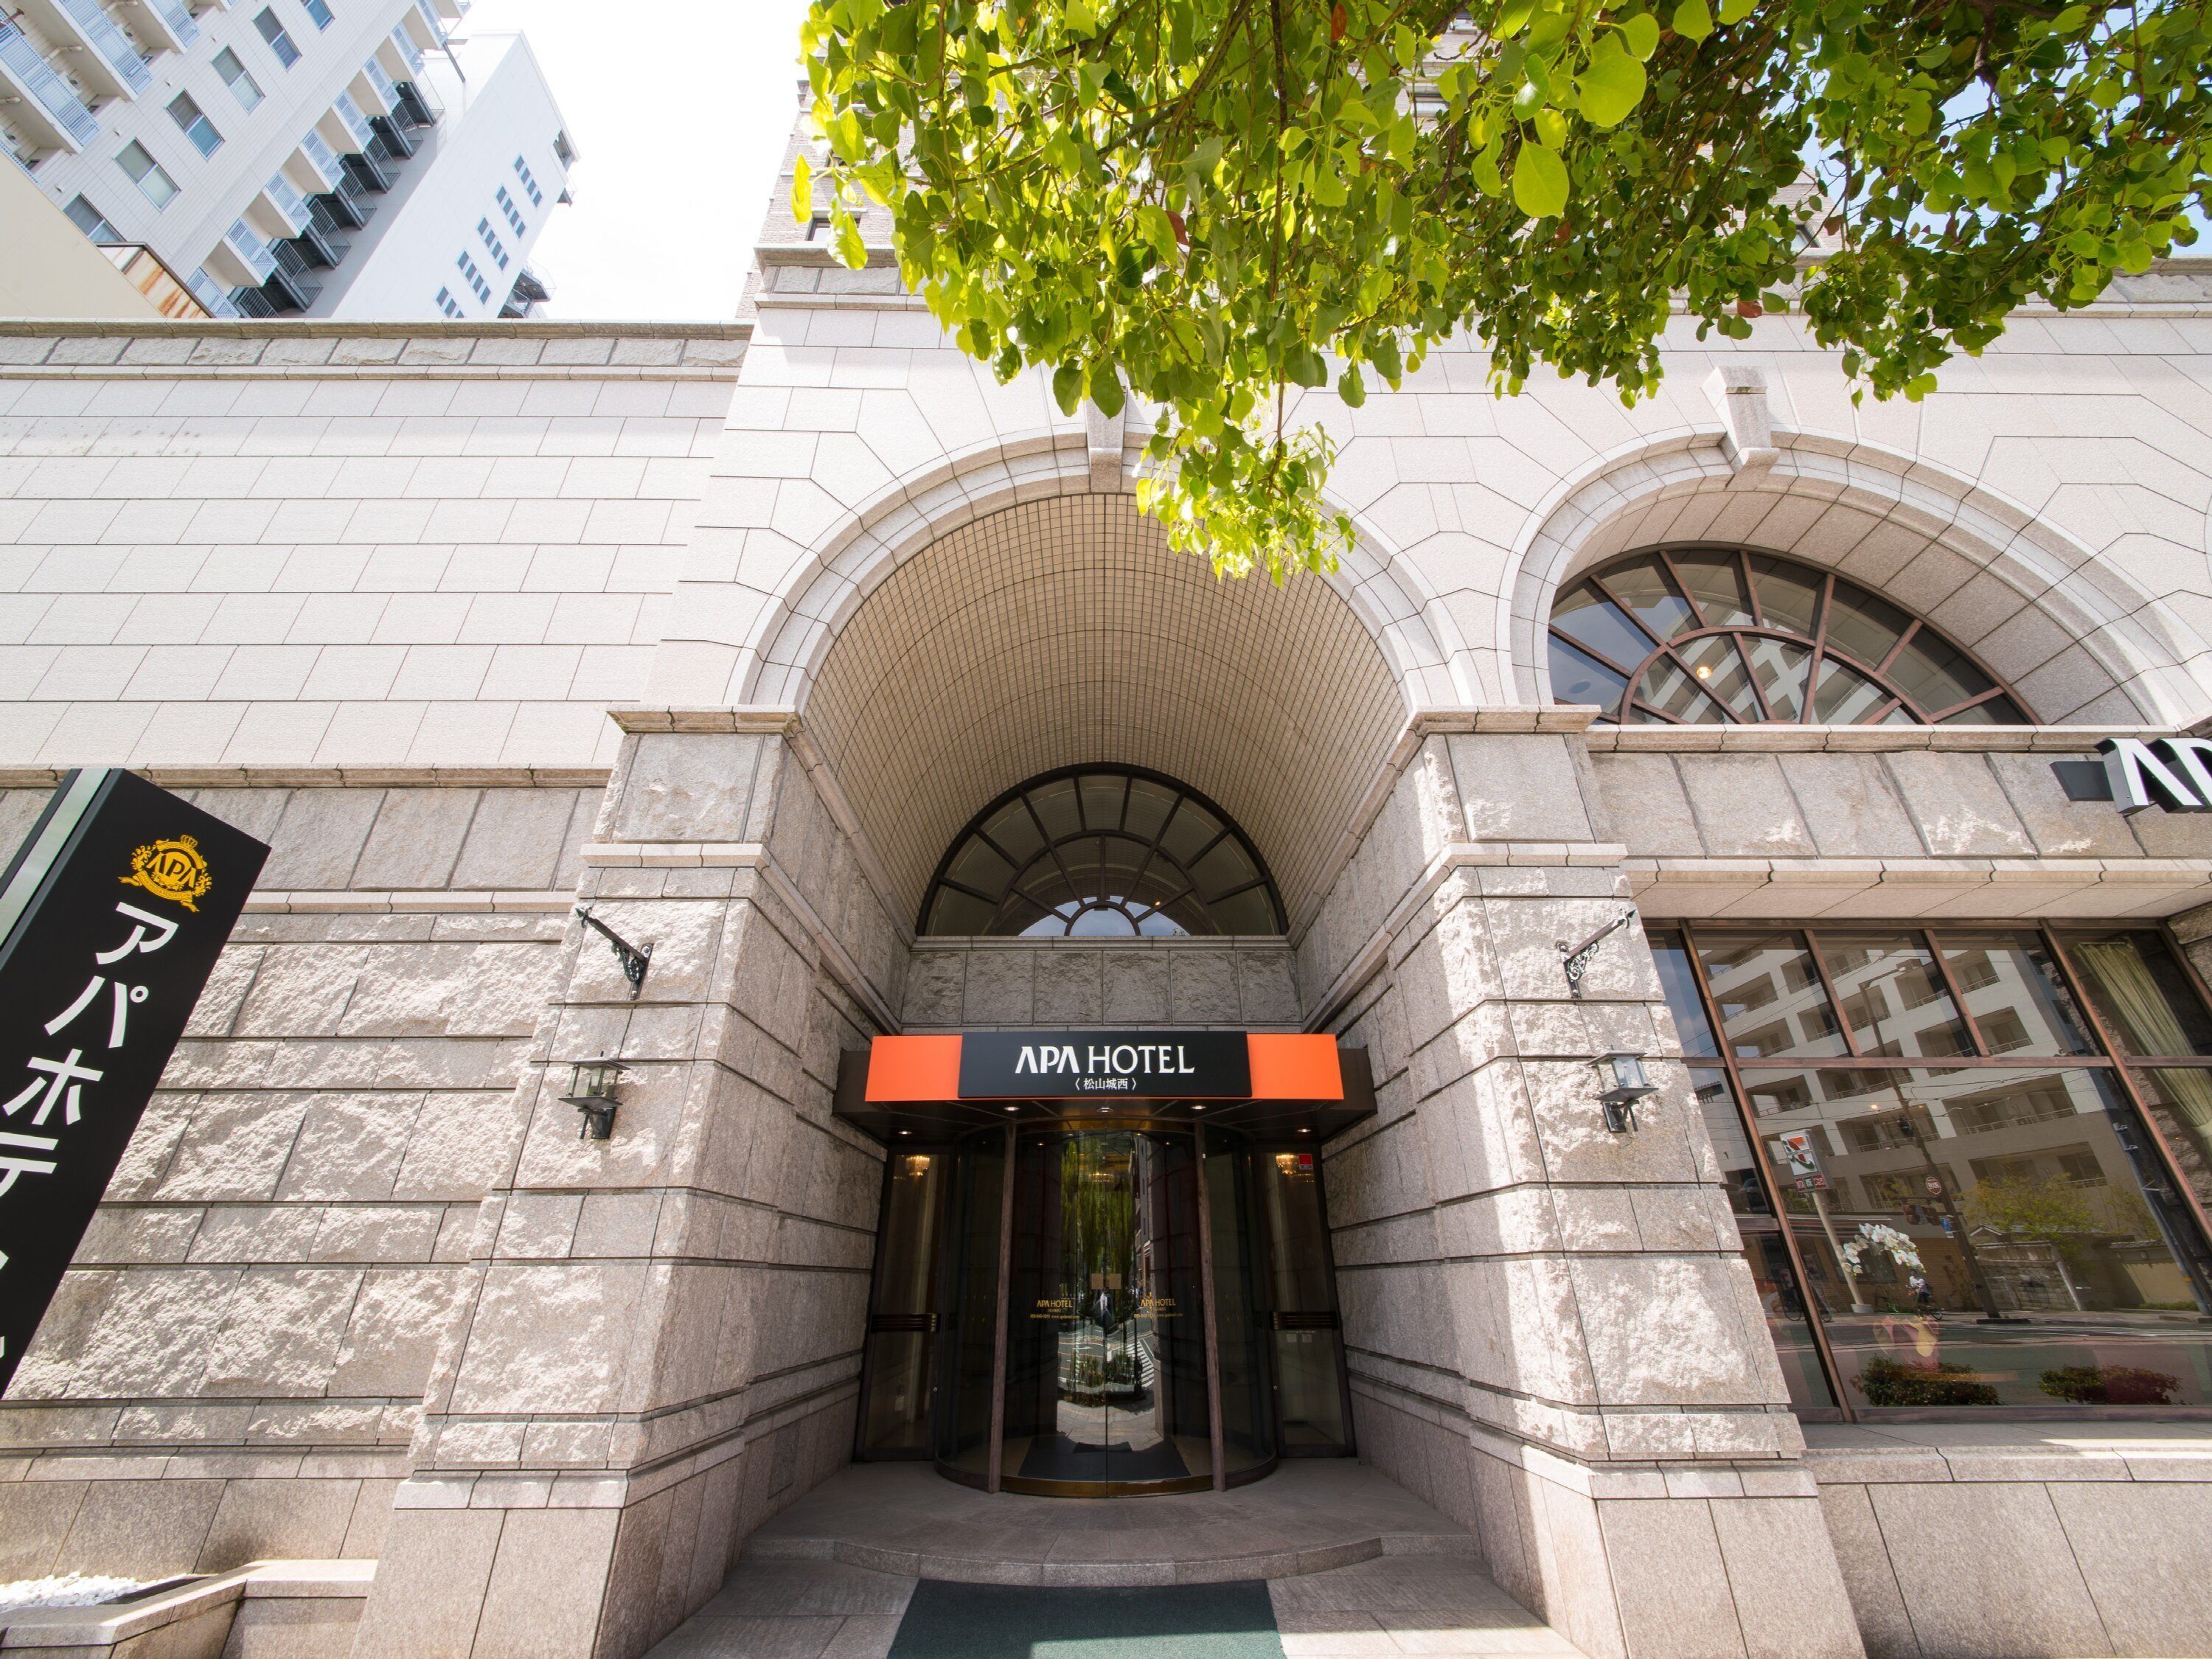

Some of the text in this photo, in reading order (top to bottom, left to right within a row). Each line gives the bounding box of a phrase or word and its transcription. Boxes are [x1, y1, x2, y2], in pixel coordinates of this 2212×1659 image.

[145, 852, 197, 888] APA
[1015, 1045, 1195, 1074] APA HOTEL
[1037, 1299, 1074, 1308] APA HOTEL
[1140, 1298, 1177, 1307] APA HOTEL
